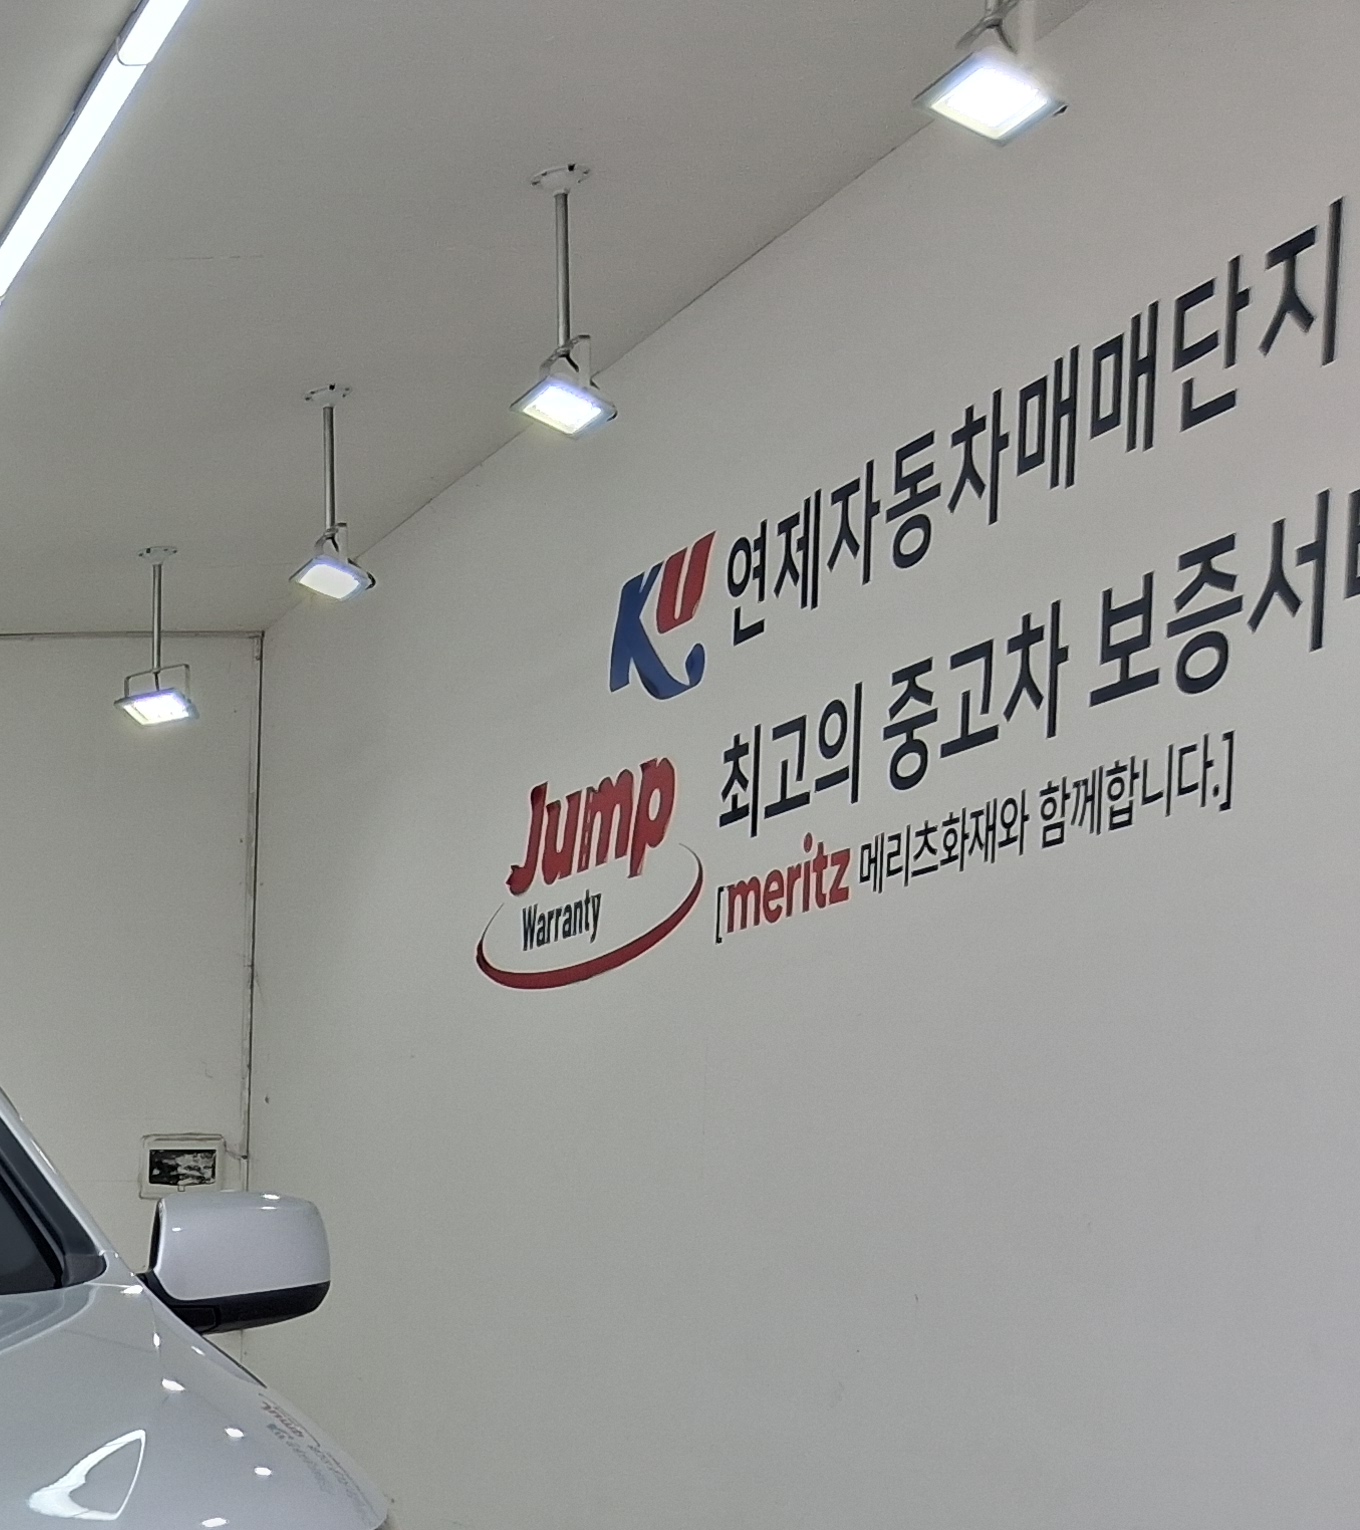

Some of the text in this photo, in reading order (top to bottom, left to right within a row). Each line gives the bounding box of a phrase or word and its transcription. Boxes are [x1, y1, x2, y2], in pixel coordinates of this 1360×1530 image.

[726, 196, 1344, 647] 연제자동차매매단지
[719, 681, 863, 838] 최고의
[882, 600, 1070, 791] 중고차
[505, 757, 676, 897] Jump
[858, 789, 1030, 894] 메리츠화재와
[522, 889, 602, 952] Warranty
